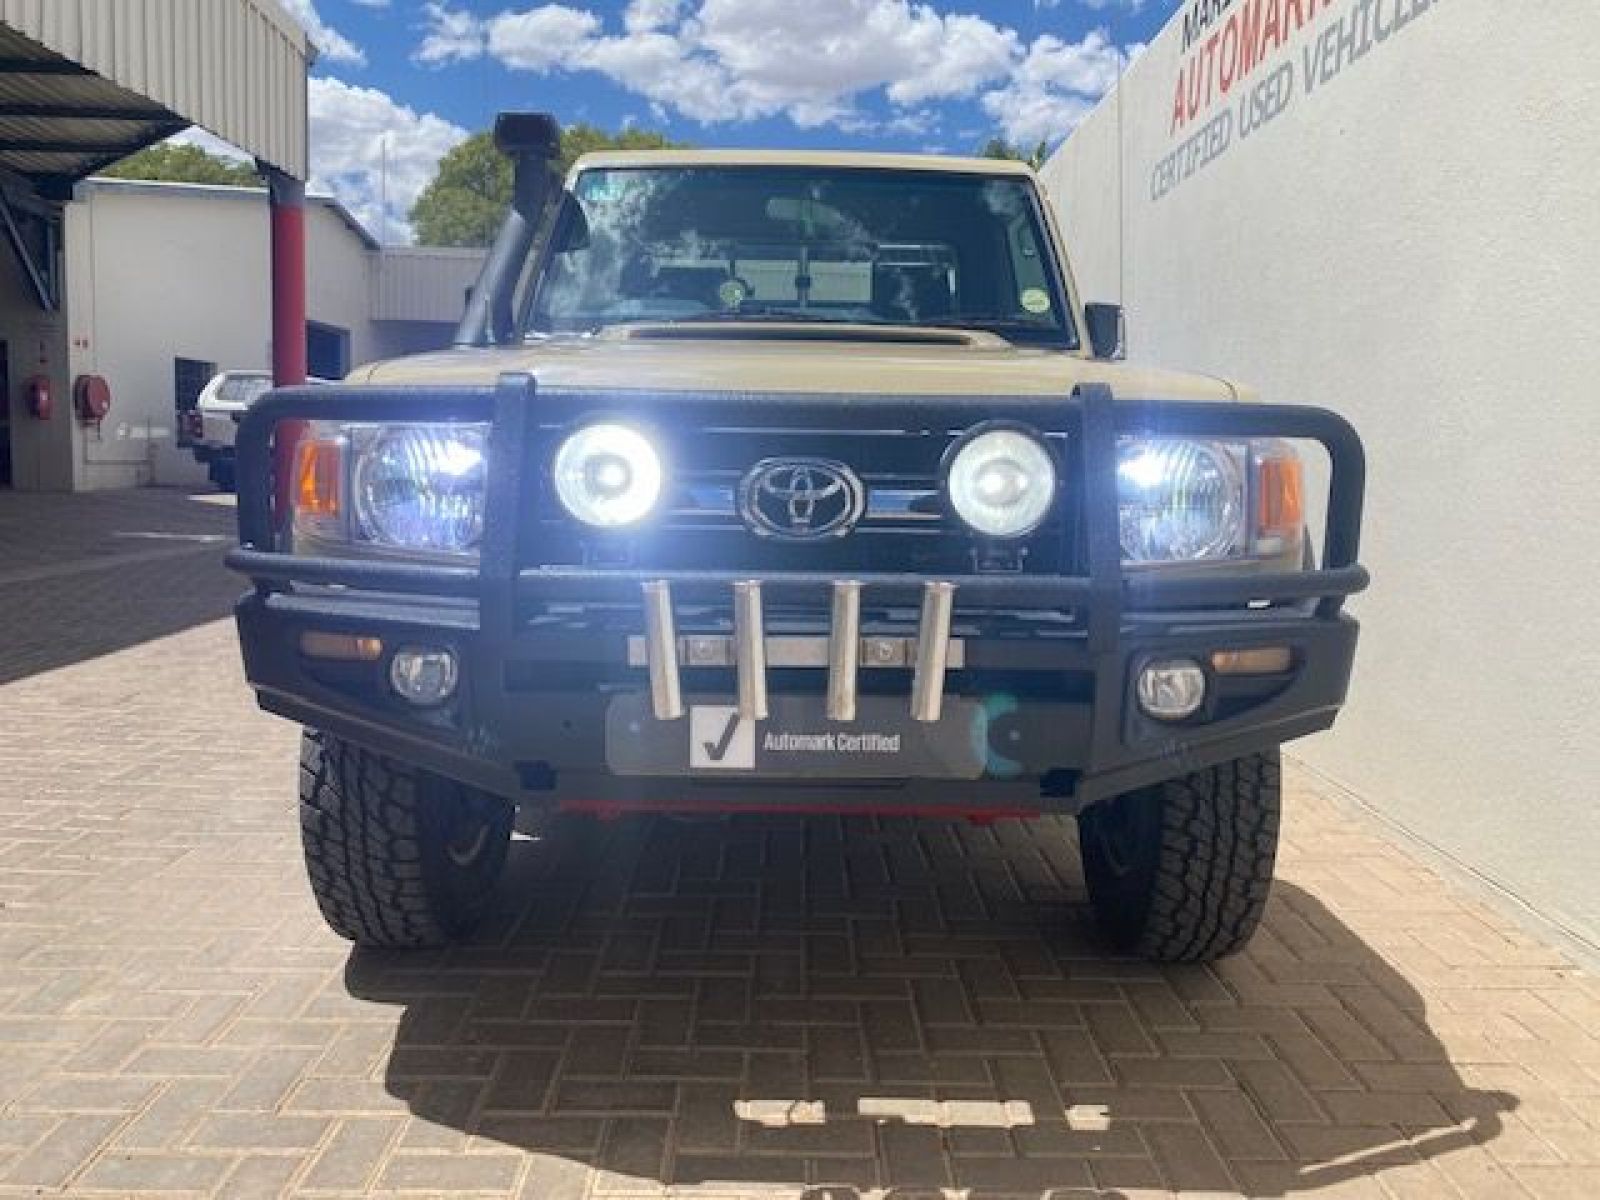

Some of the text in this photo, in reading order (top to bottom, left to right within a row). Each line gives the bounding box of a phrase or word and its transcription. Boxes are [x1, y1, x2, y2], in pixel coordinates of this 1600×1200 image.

[1151, 0, 1438, 200] CERTIFIED USED VEHICL
[1169, 0, 1331, 137] AUTOMAR
[764, 731, 901, 753] Automark Certified
